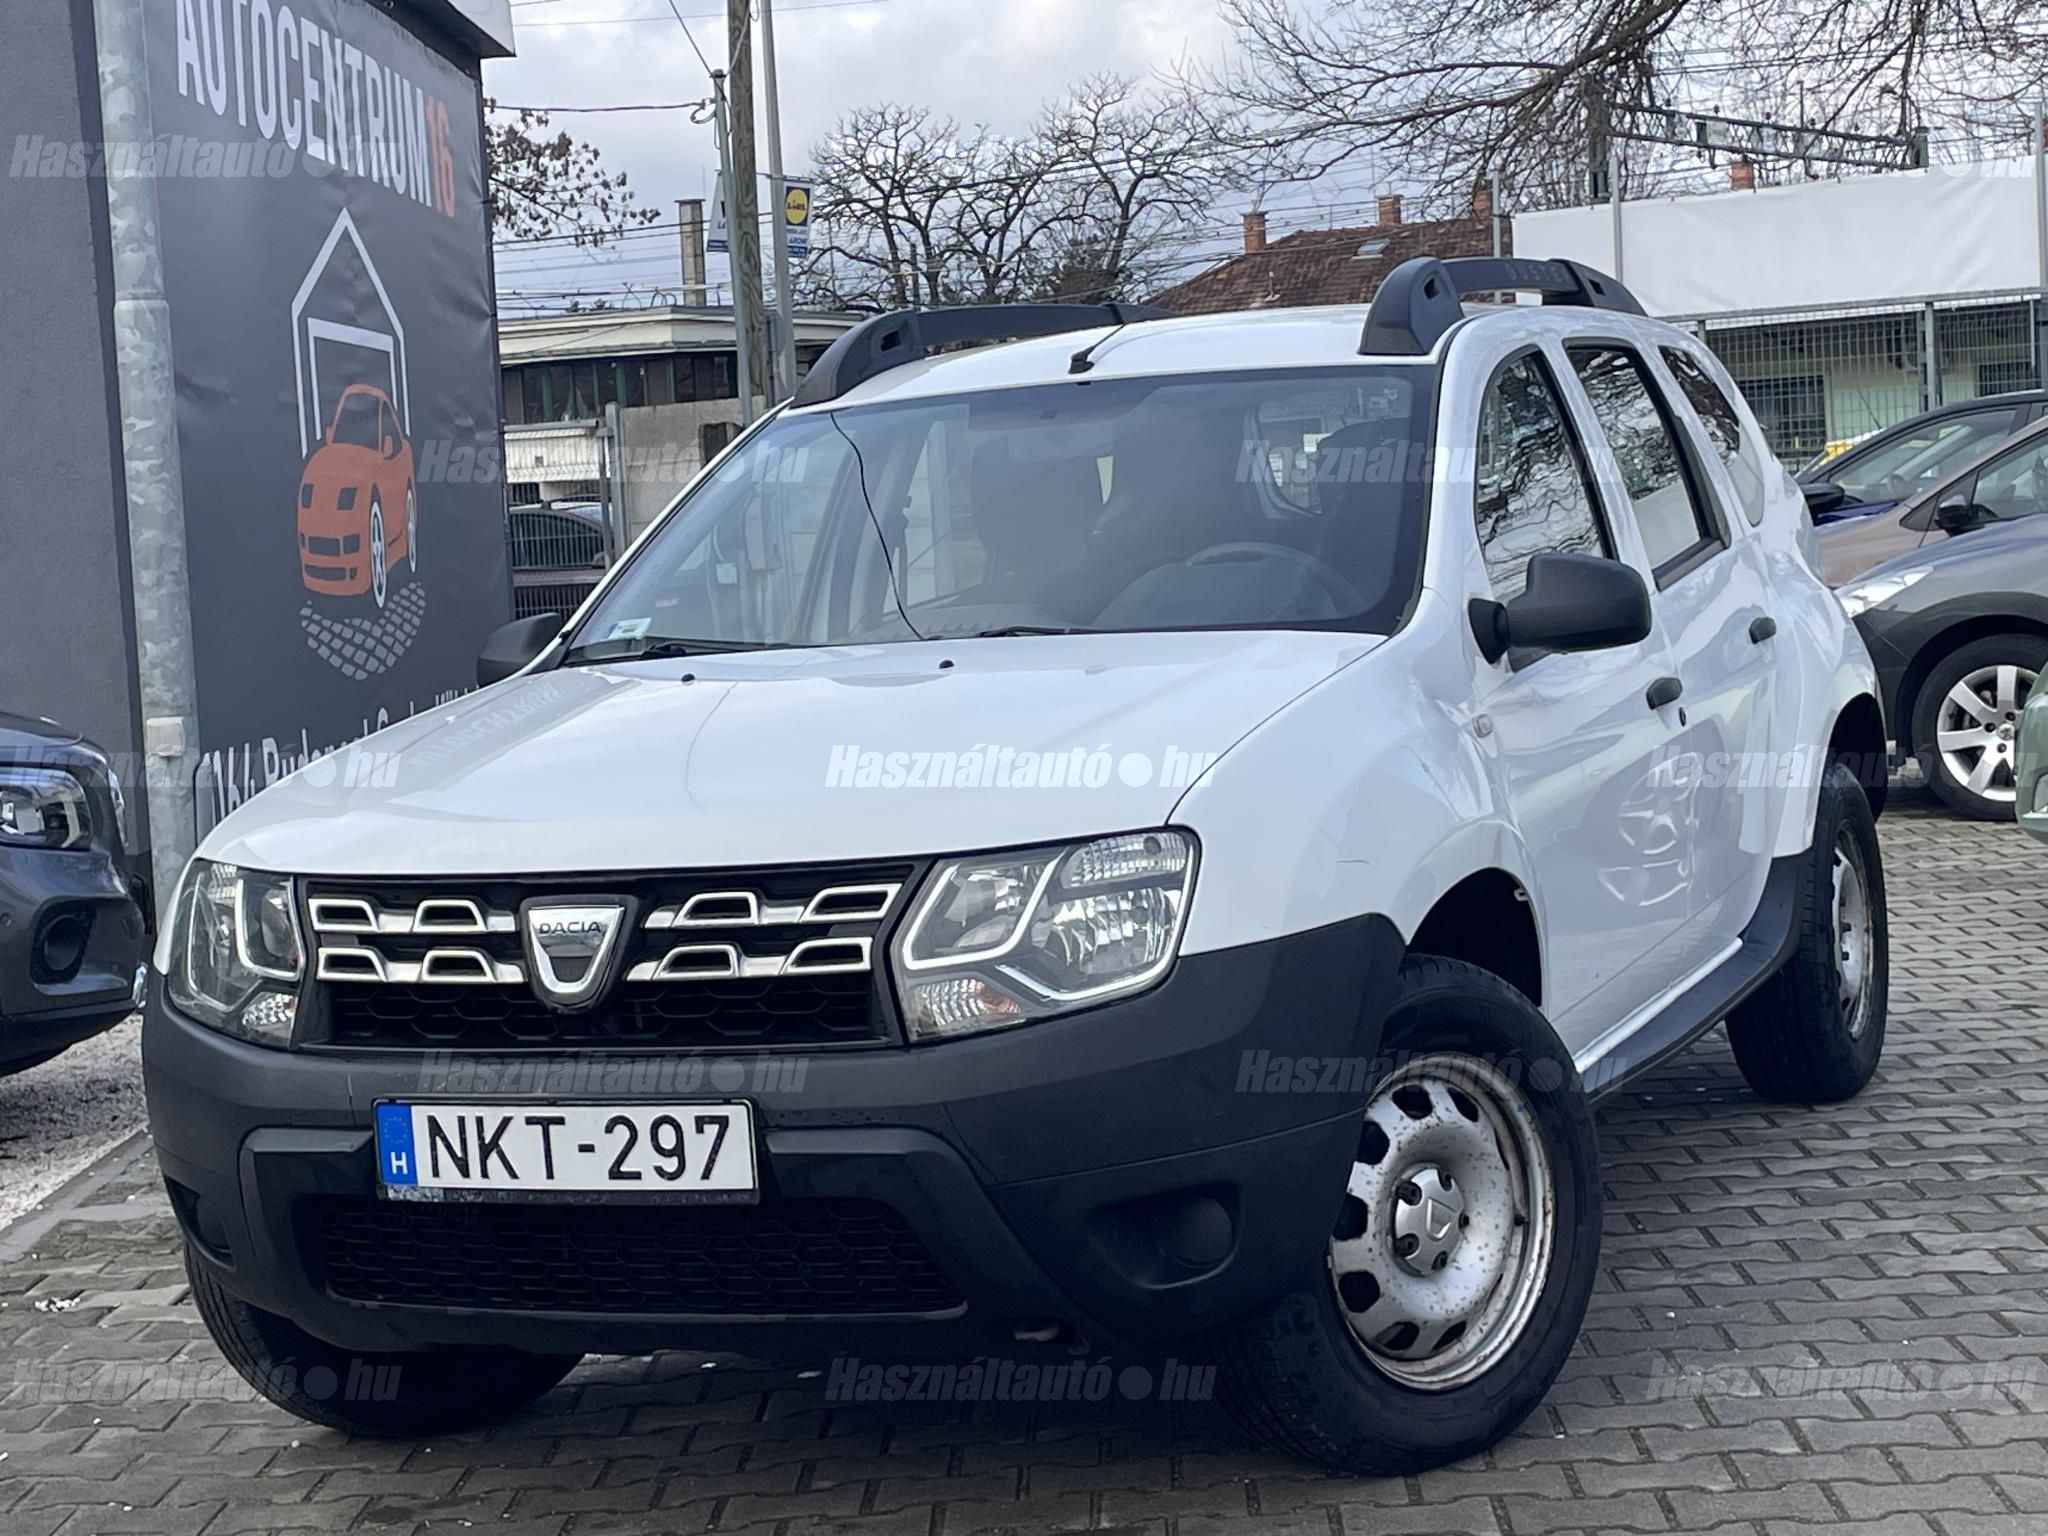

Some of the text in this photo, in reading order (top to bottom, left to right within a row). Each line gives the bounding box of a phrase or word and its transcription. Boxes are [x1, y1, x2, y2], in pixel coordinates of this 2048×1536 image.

[539, 921, 601, 934] DACIA
[426, 1114, 730, 1181] NKT-297
[391, 1151, 408, 1176] H
